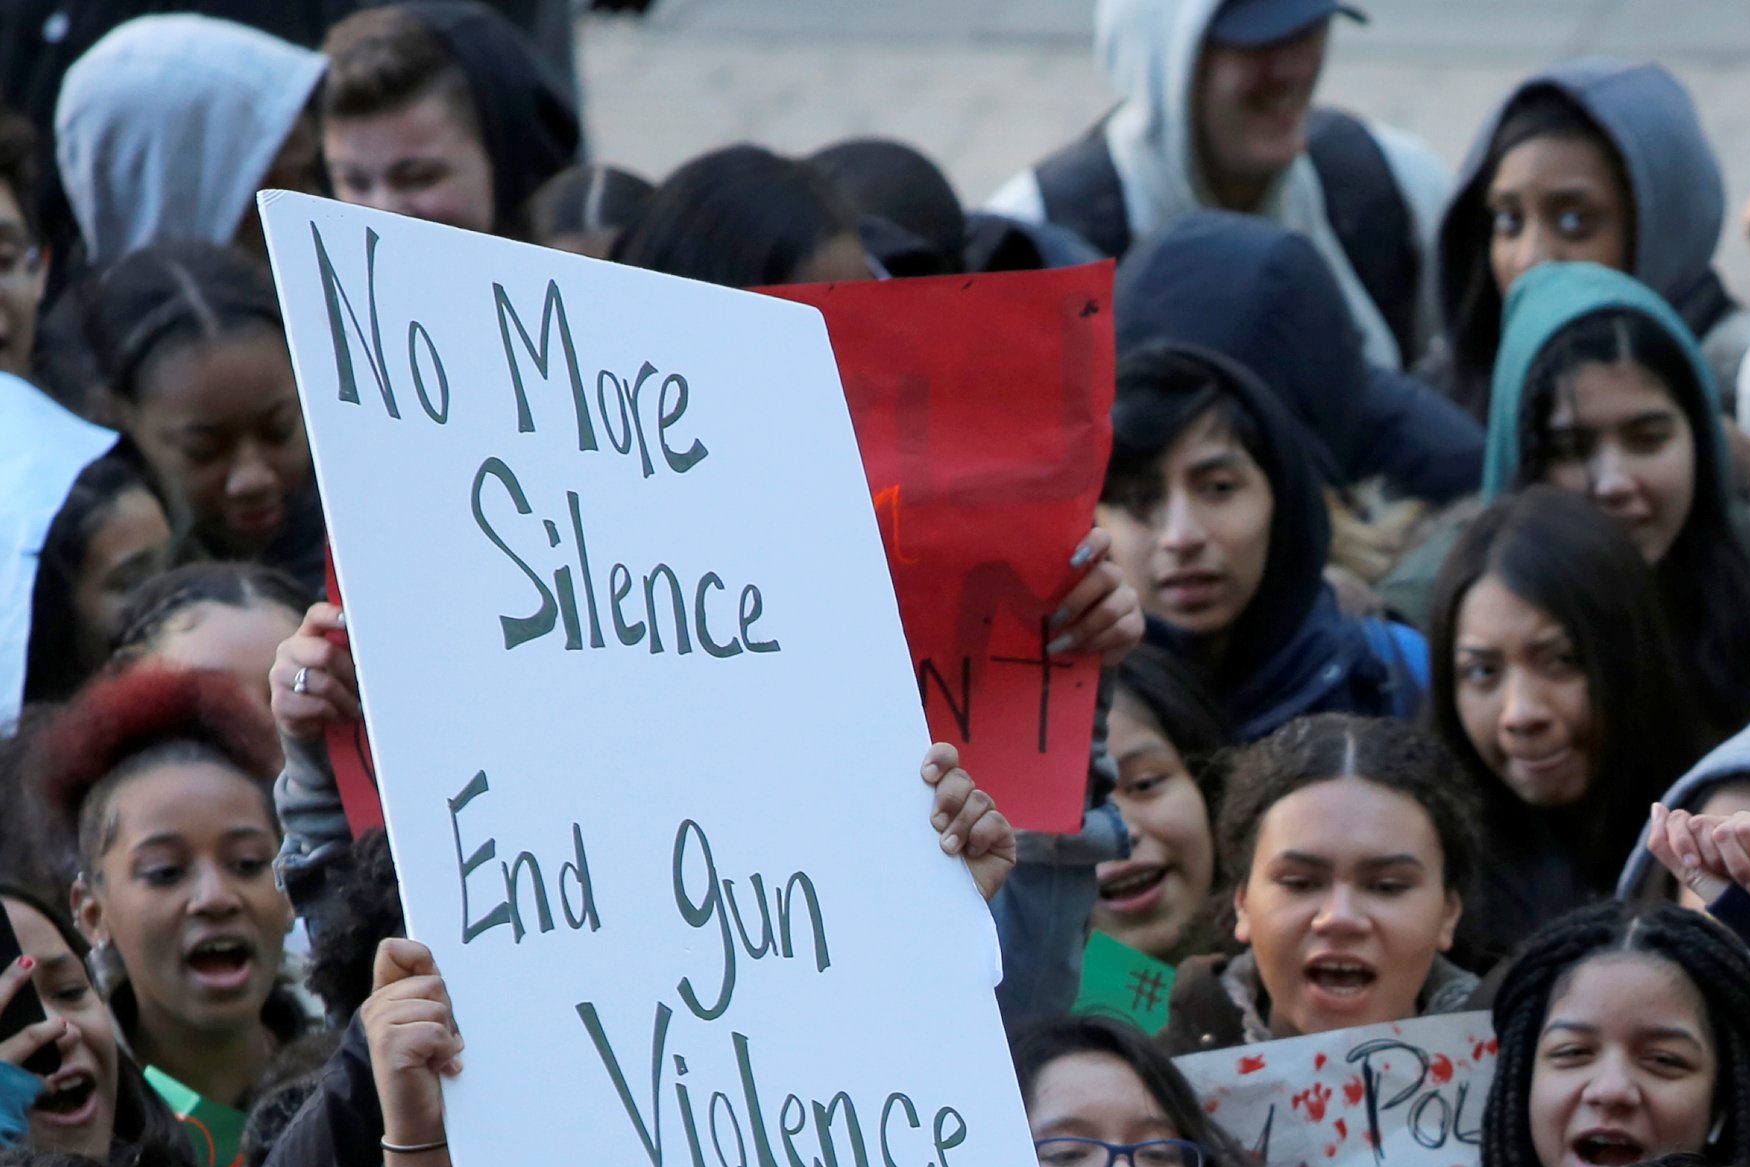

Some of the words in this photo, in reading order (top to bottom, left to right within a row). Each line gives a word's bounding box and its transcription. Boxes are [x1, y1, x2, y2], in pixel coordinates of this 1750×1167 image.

[310, 221, 450, 425] No
[492, 280, 707, 479] More
[471, 458, 781, 659] Silence
[447, 769, 601, 945] End
[673, 819, 831, 1021] gun
